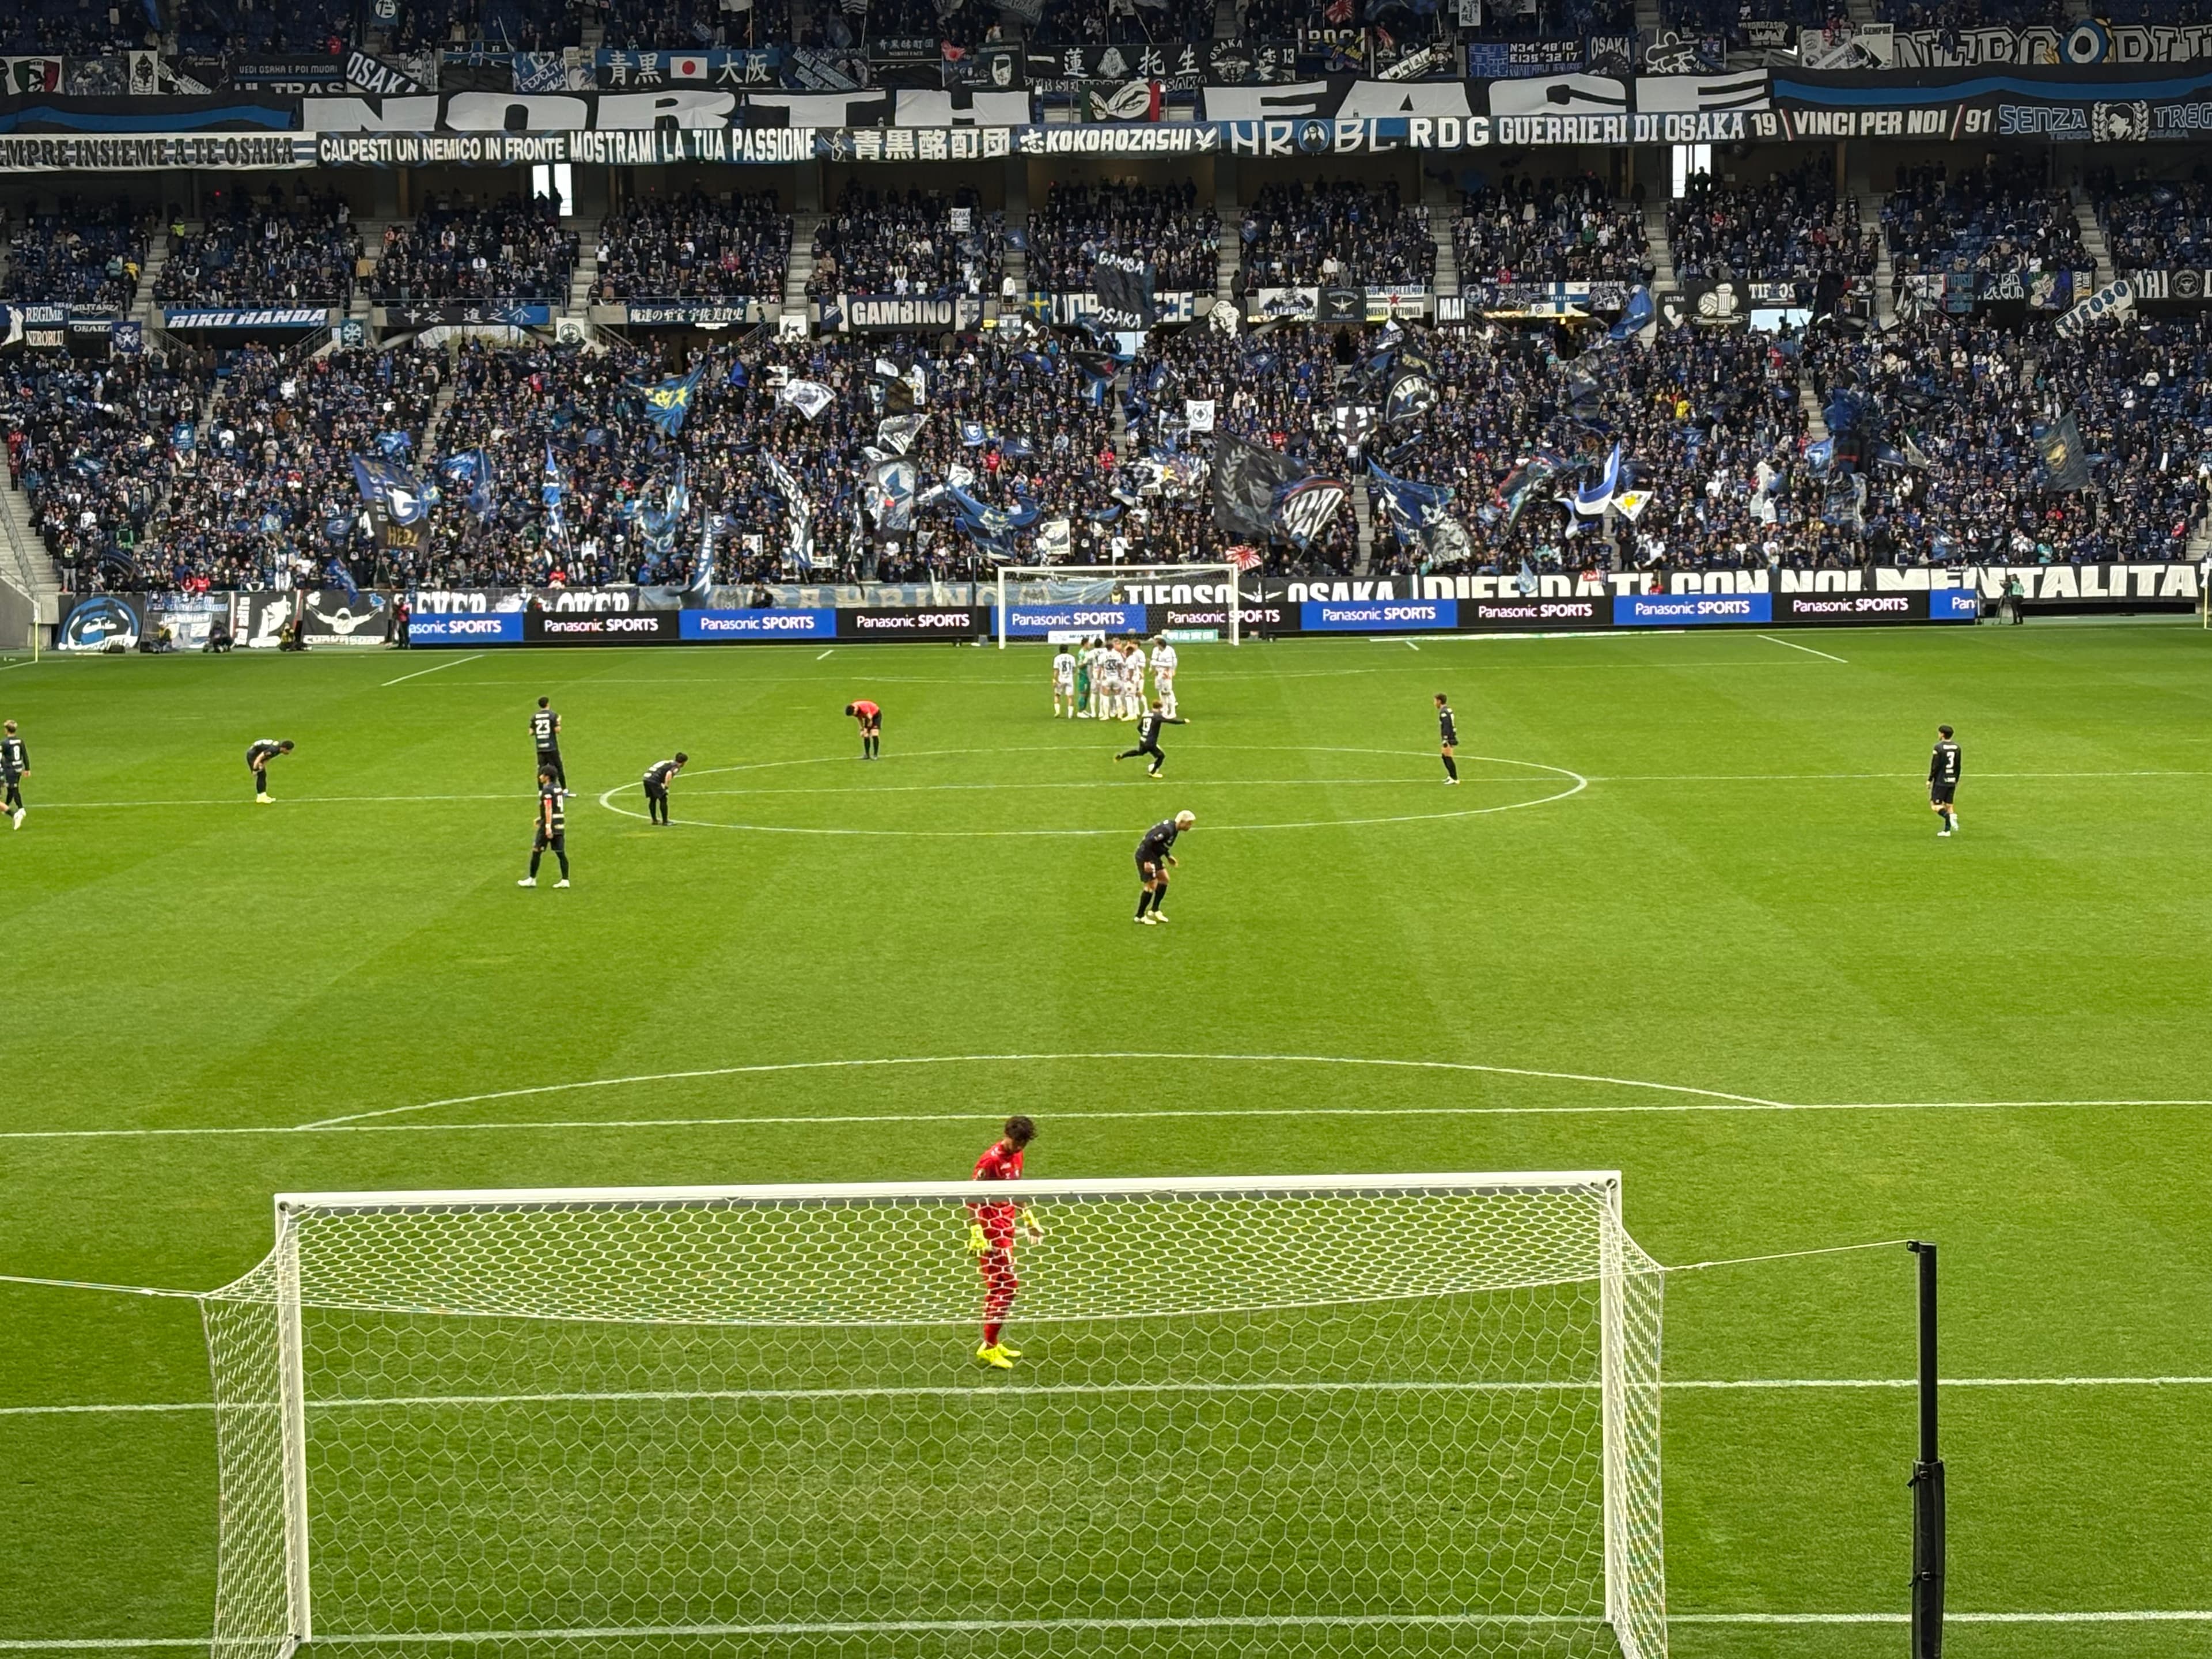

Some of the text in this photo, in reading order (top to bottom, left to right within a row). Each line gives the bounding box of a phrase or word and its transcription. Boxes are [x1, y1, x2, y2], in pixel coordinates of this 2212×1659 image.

[1209, 39, 1243, 60] OSAKA
[1590, 36, 1631, 63] OSAKA
[289, 65, 293, 74] E
[296, 65, 309, 74] POI
[607, 51, 662, 85] 青黒
[716, 53, 772, 84] 大阪
[1203, 68, 1770, 120] FACE
[1792, 110, 1856, 135] VINCI
[1860, 111, 1903, 135] PER
[1907, 109, 1948, 134] NOI
[1999, 104, 2087, 135] SENZA
[1410, 116, 1492, 149] RDG
[1499, 113, 1778, 145] GUERRIERI DI OSAKA 19
[320, 137, 565, 162] CALPESTI UN NEMICO IN FRONTE
[570, 128, 816, 164] MOSTRAMI LA TUA PASSIONE
[853, 127, 1010, 161] 青黒酩酊団
[1046, 128, 1191, 153] KOKOROZASHI
[75, 139, 168, 166] INSIEME
[173, 139, 193, 166] A
[194, 139, 219, 166] TE
[225, 137, 296, 165] OSAKA
[1098, 251, 1145, 275] GAMBA
[1977, 286, 2025, 301] REGUA
[404, 307, 531, 324] 中谷 進之介
[851, 300, 952, 325] GAMBINO
[1098, 306, 1142, 329] OSAKA
[1440, 298, 1465, 320] MAI
[168, 309, 328, 328] RIKU HANDA
[73, 324, 112, 333] OSAKA
[26, 329, 64, 347] NEROBLU
[1671, 569, 1770, 595] CON
[1781, 569, 1862, 593] NOI
[1287, 581, 1395, 602] OSAKA
[1478, 603, 1593, 619] Panasonic SPORTS
[1635, 600, 1750, 616] Panasonic SPORTS
[1793, 597, 1908, 612] Panasonic SPORTS
[1952, 597, 1975, 609] Pan
[700, 615, 815, 630] Panasonic SPORTS
[857, 613, 970, 628] Panasonic SPORTS
[1012, 611, 1125, 626] Panasonic SPORTS
[1168, 609, 1226, 624] Panasonic
[1323, 606, 1436, 622] Panasonic SPORTS
[449, 619, 502, 634] SPORTS
[544, 617, 659, 632] Panasonic SPORTS
[1061, 661, 1072, 673] 81
[535, 719, 551, 734] 23
[13, 745, 20, 760] 8
[1945, 751, 1955, 768] 3
[556, 794, 564, 812] 4
